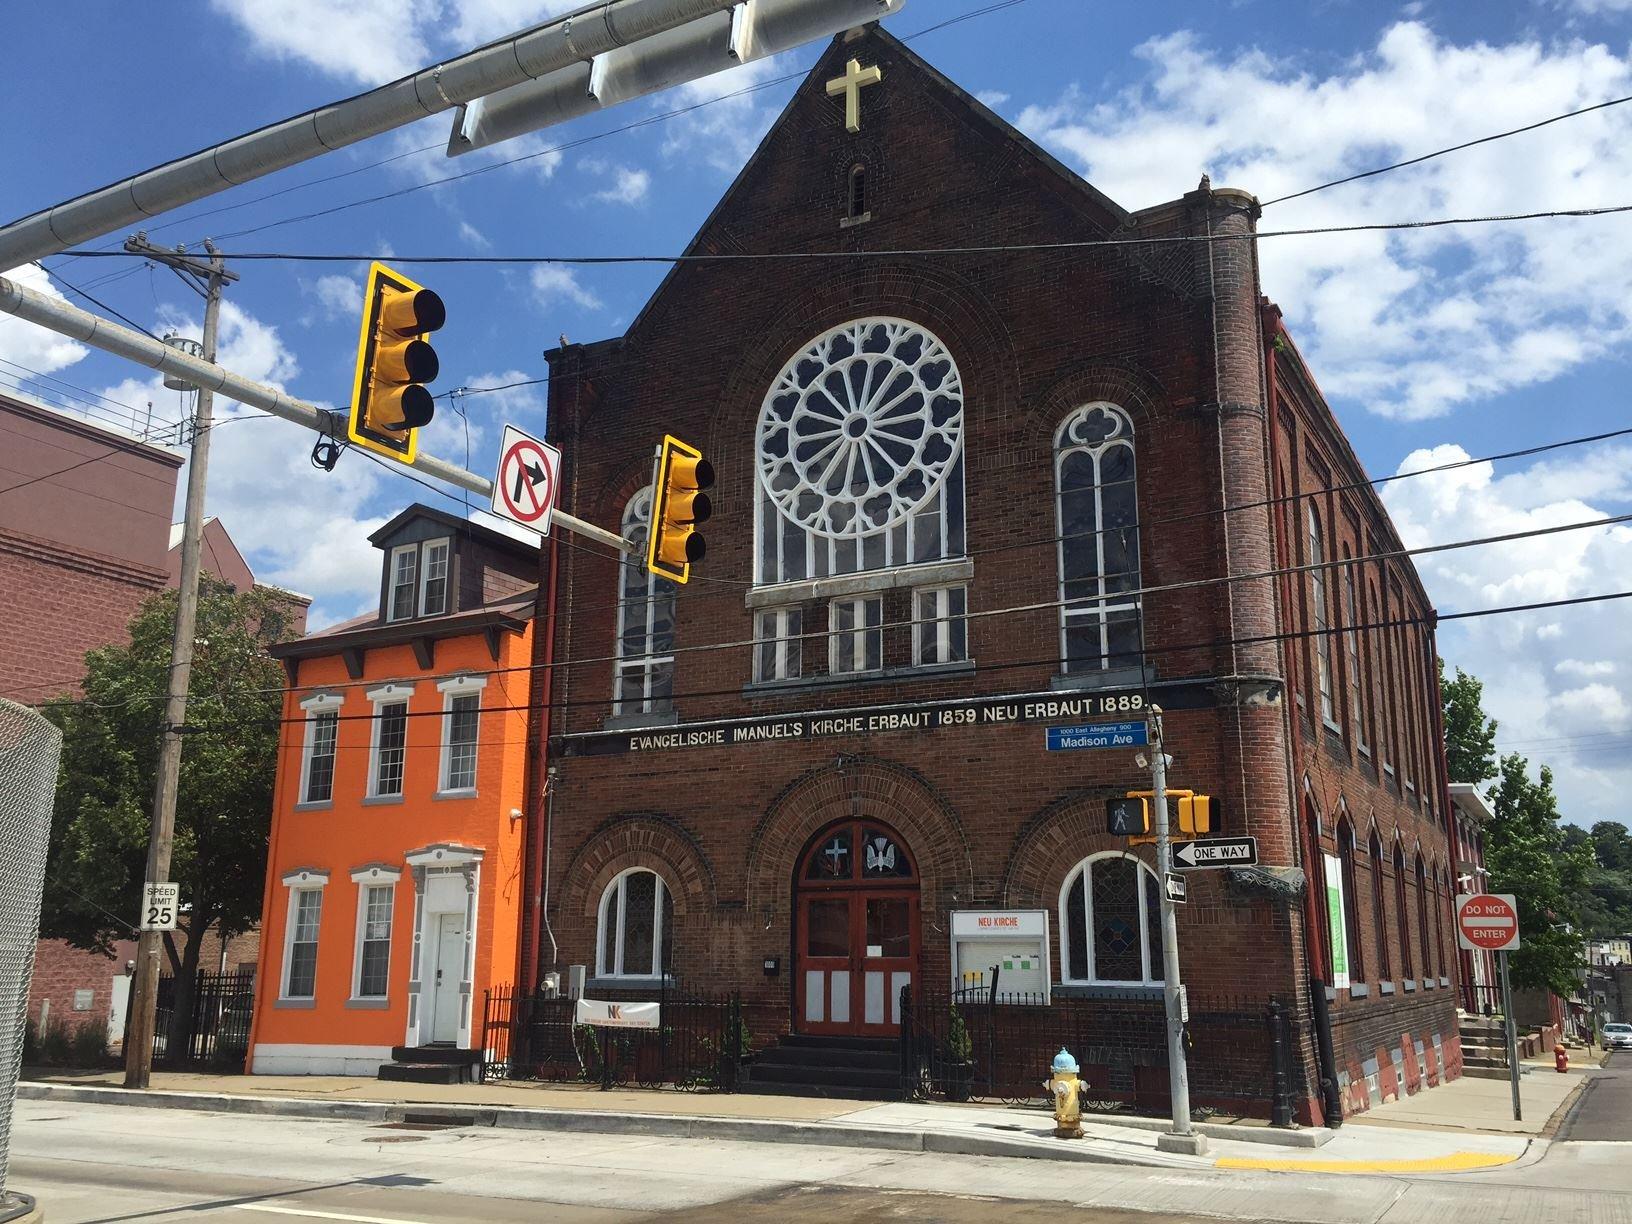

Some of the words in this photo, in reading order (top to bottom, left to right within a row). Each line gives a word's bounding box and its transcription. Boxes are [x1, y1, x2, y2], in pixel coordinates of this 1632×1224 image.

[630, 729, 725, 750] EVANGELISCHE
[733, 721, 803, 742] IMANUEL'S
[869, 712, 931, 731] ERBAUT
[938, 708, 977, 725] 1859
[984, 705, 1018, 722] NEU
[1025, 699, 1093, 719] ERBAUT
[1089, 726, 1117, 734] Allegheny
[1061, 736, 1108, 748] Madison
[1112, 734, 1133, 745] Ave
[1194, 848, 1216, 859] ONE
[1220, 846, 1246, 858] WAY
[147, 888, 176, 896] SPEED
[150, 897, 172, 905] LIMIT
[1466, 905, 1481, 914] DO
[1485, 905, 1506, 914] NOT
[147, 907, 172, 925] 25
[978, 917, 992, 927] NEU
[993, 917, 1018, 927] KIRCHE
[1473, 929, 1507, 939] ENTER
[608, 1005, 622, 1019] NK
